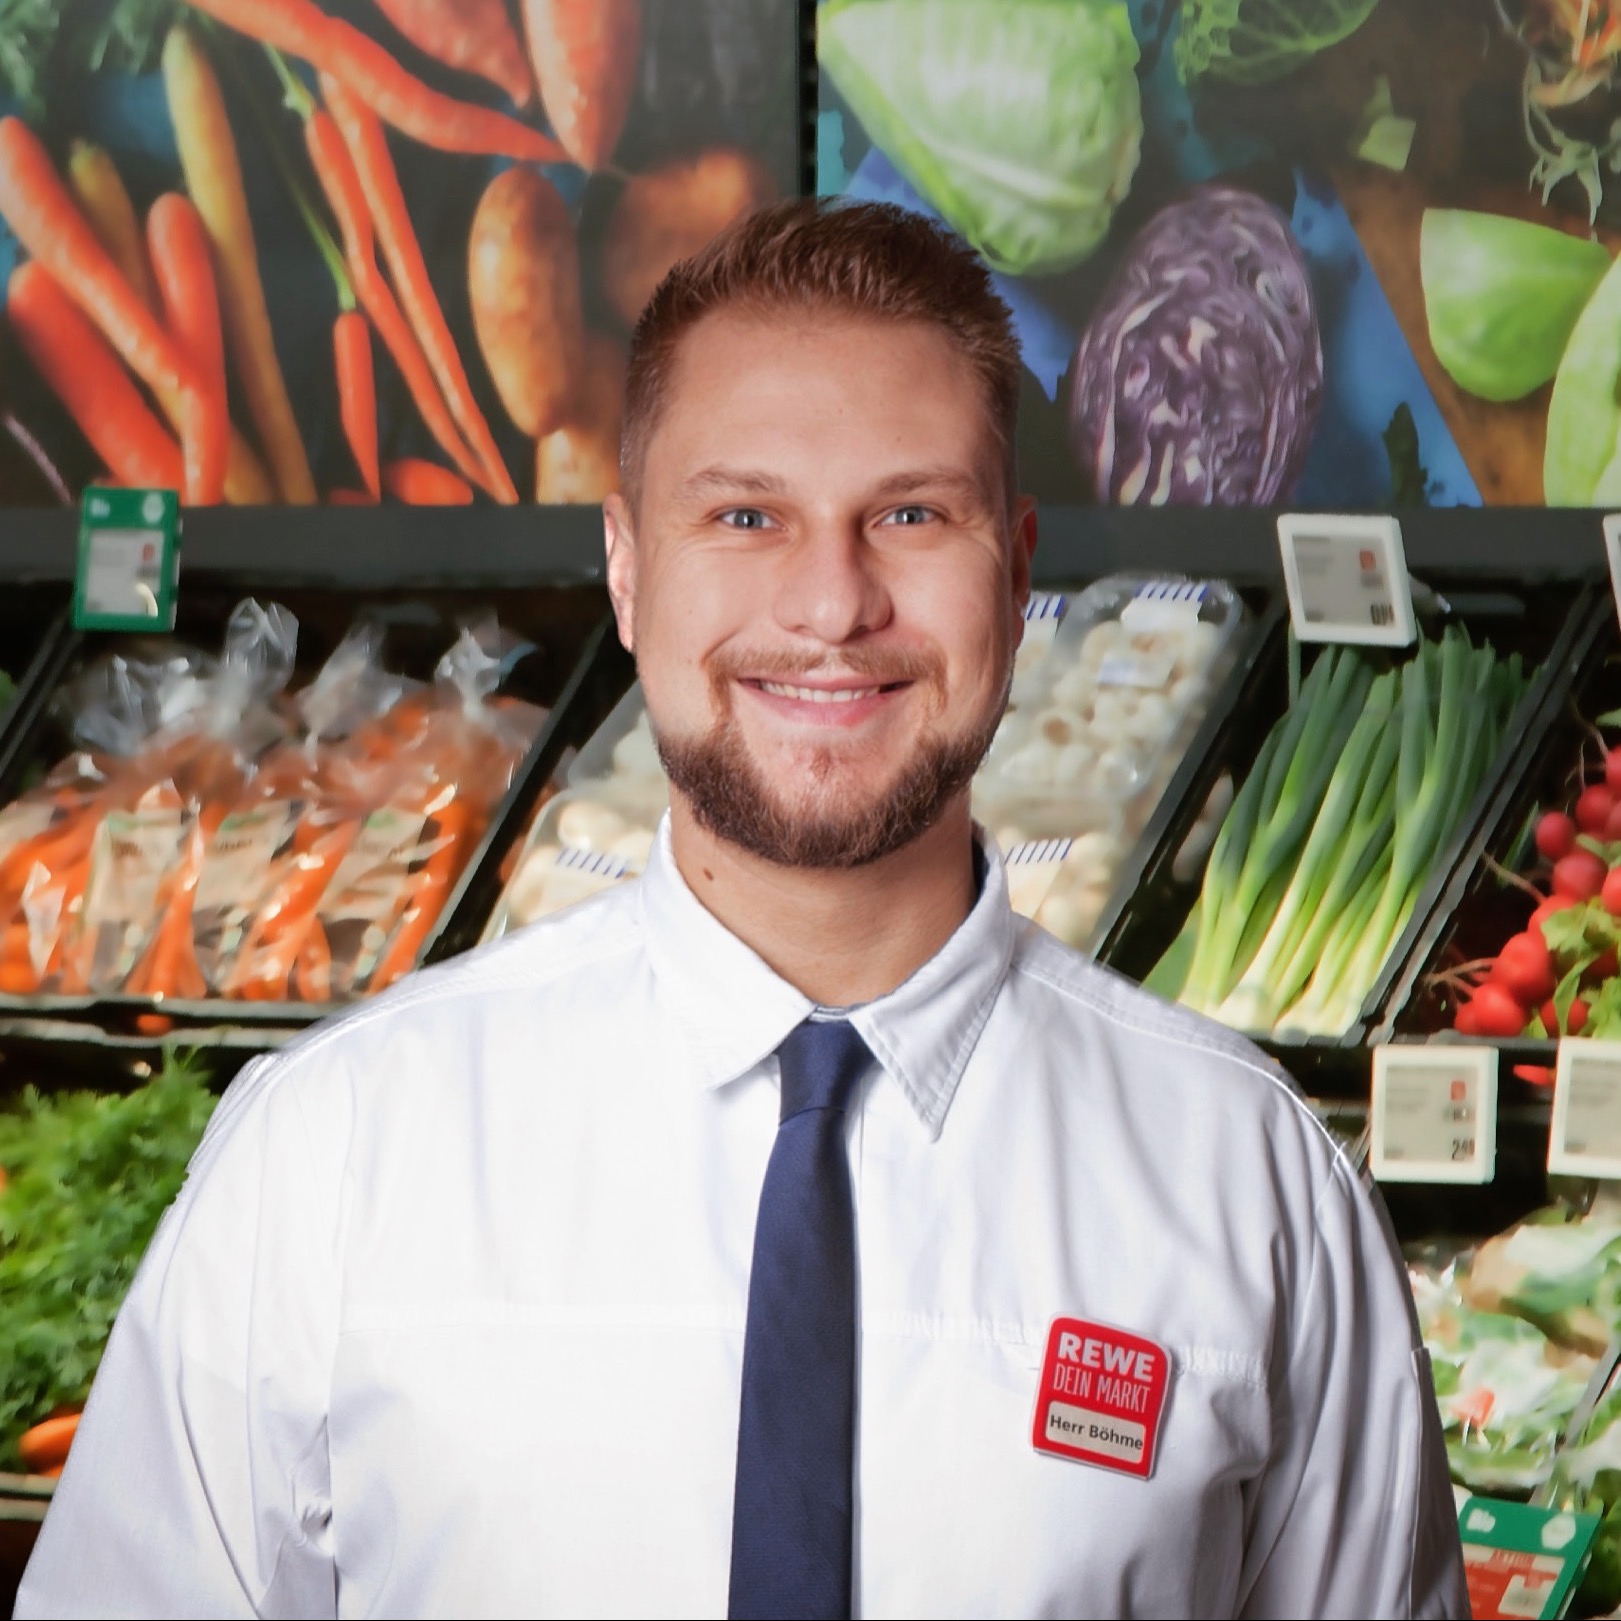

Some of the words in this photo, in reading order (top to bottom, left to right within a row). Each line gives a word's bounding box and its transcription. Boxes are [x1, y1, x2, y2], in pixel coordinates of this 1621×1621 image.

[1058, 1332, 1155, 1382] REWE
[1053, 1363, 1092, 1398] DEIN
[1096, 1375, 1150, 1413] MARKT
[1050, 1415, 1084, 1434] Herr
[1089, 1425, 1143, 1449] Böhme
